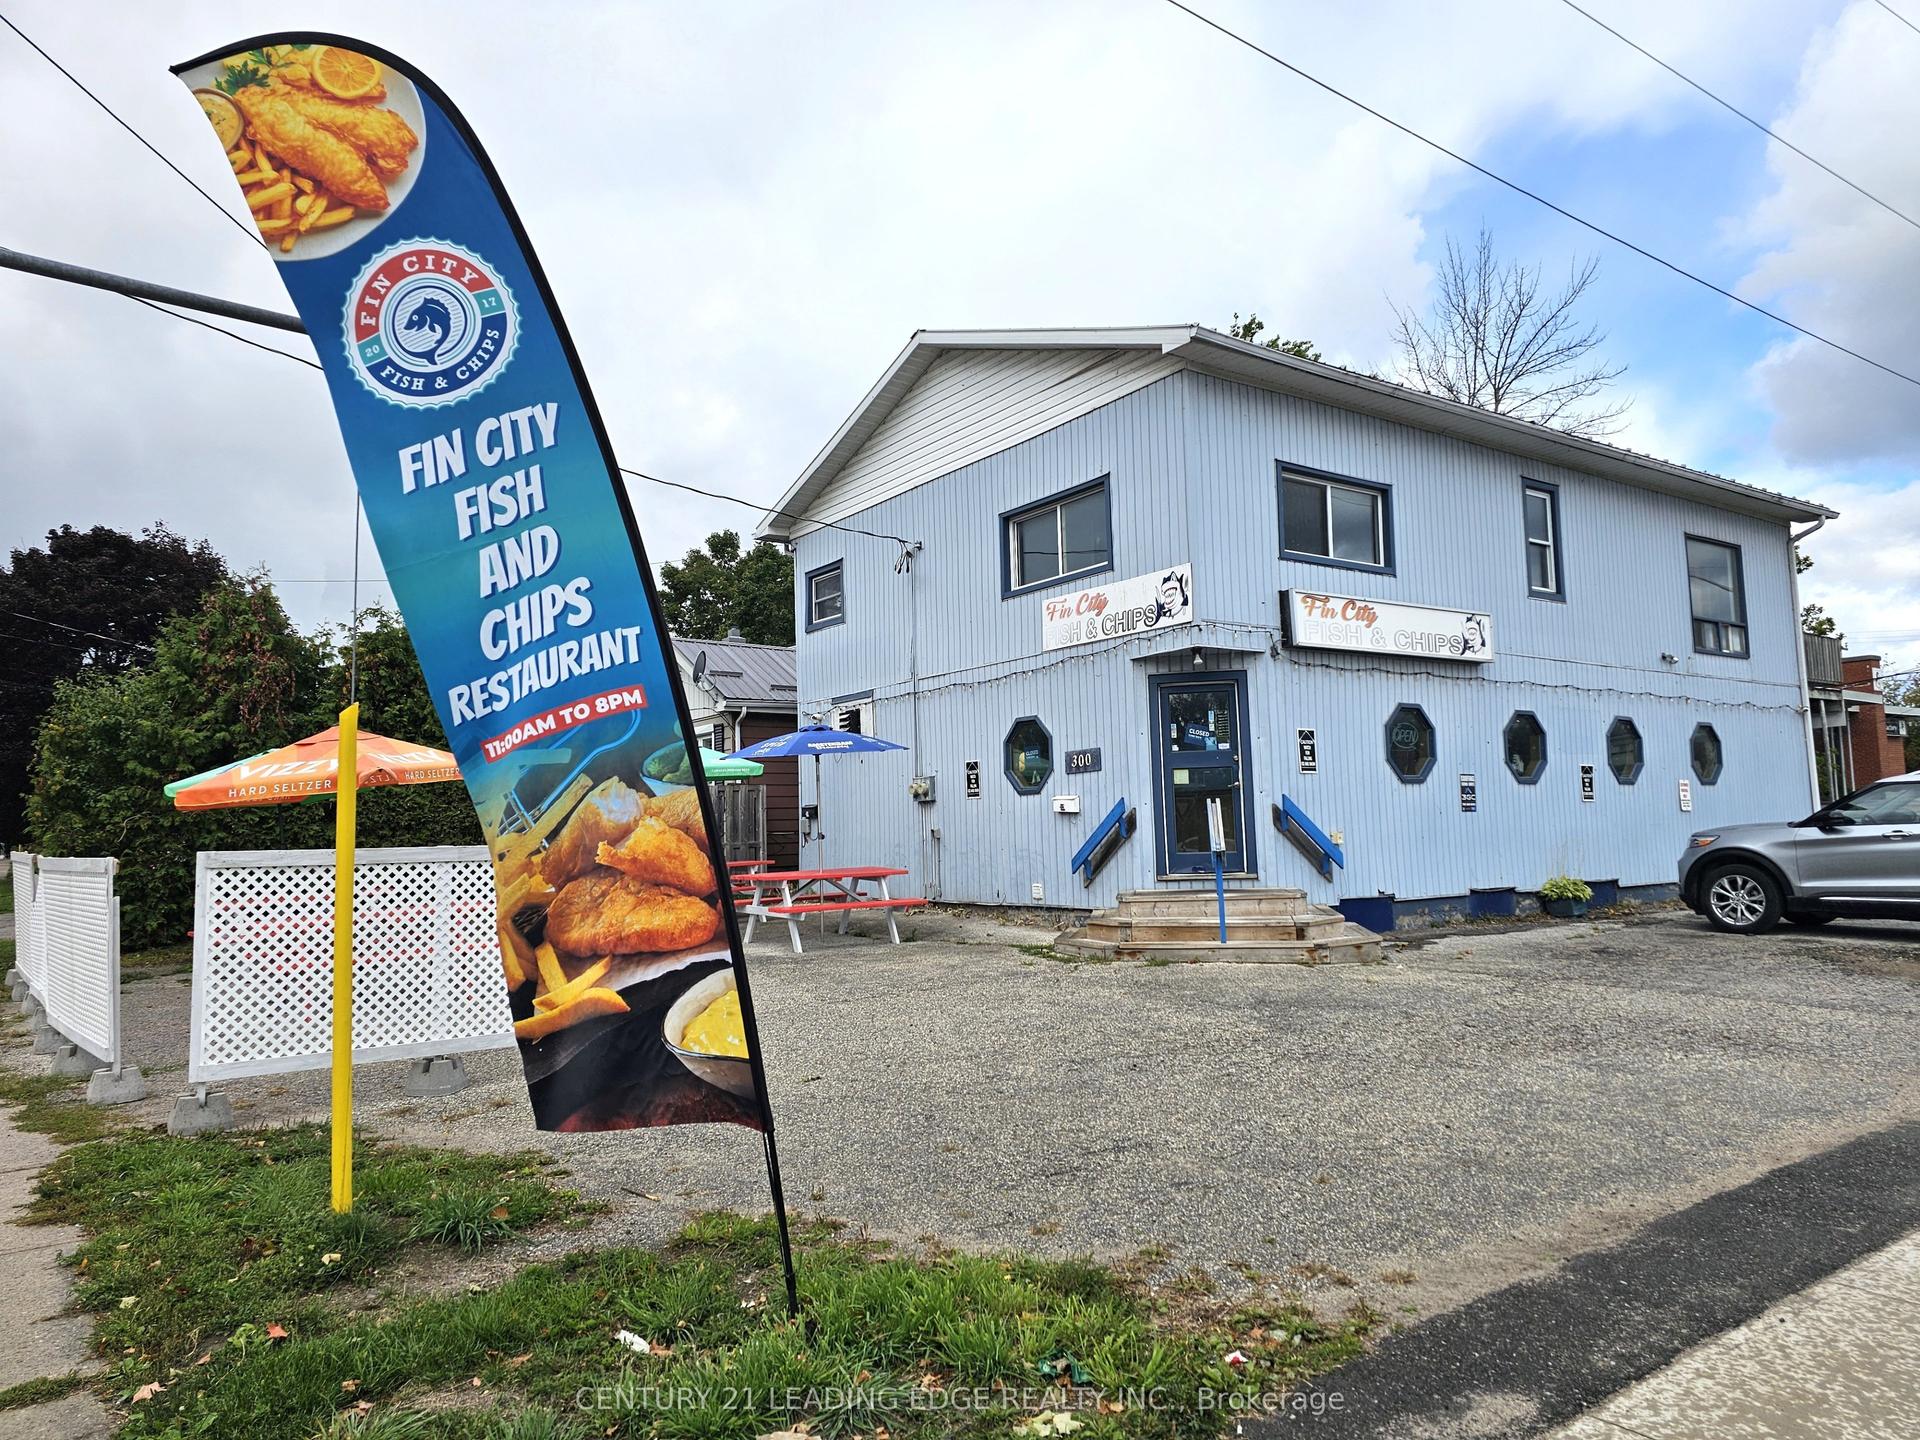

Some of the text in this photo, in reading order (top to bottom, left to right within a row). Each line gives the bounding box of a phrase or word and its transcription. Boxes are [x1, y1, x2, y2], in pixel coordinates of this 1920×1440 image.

[360, 255, 479, 327] FIN CITY
[481, 297, 497, 309] 17
[364, 344, 381, 357] 20
[380, 328, 500, 391] FISH & CHIPS
[398, 402, 558, 495] FIN CITY
[454, 464, 545, 541] FISH
[479, 525, 560, 599] AND
[479, 576, 594, 661] CHIPS
[1046, 592, 1109, 622] Fin City
[1301, 594, 1379, 628] Fin City
[1045, 604, 1158, 651] FISH & CHIPS
[1304, 620, 1465, 656] FISH & CHIPS
[447, 626, 641, 727] RESTAURANT
[484, 689, 643, 758] 11:00AM TO 8PM
[1188, 728, 1210, 737] CLOSED
[1393, 727, 1418, 743] OPEN
[404, 767, 460, 780] HARD SELTZER
[1071, 753, 1092, 768] 300
[228, 785, 267, 798] HARD
[273, 779, 332, 793] SELTZER
